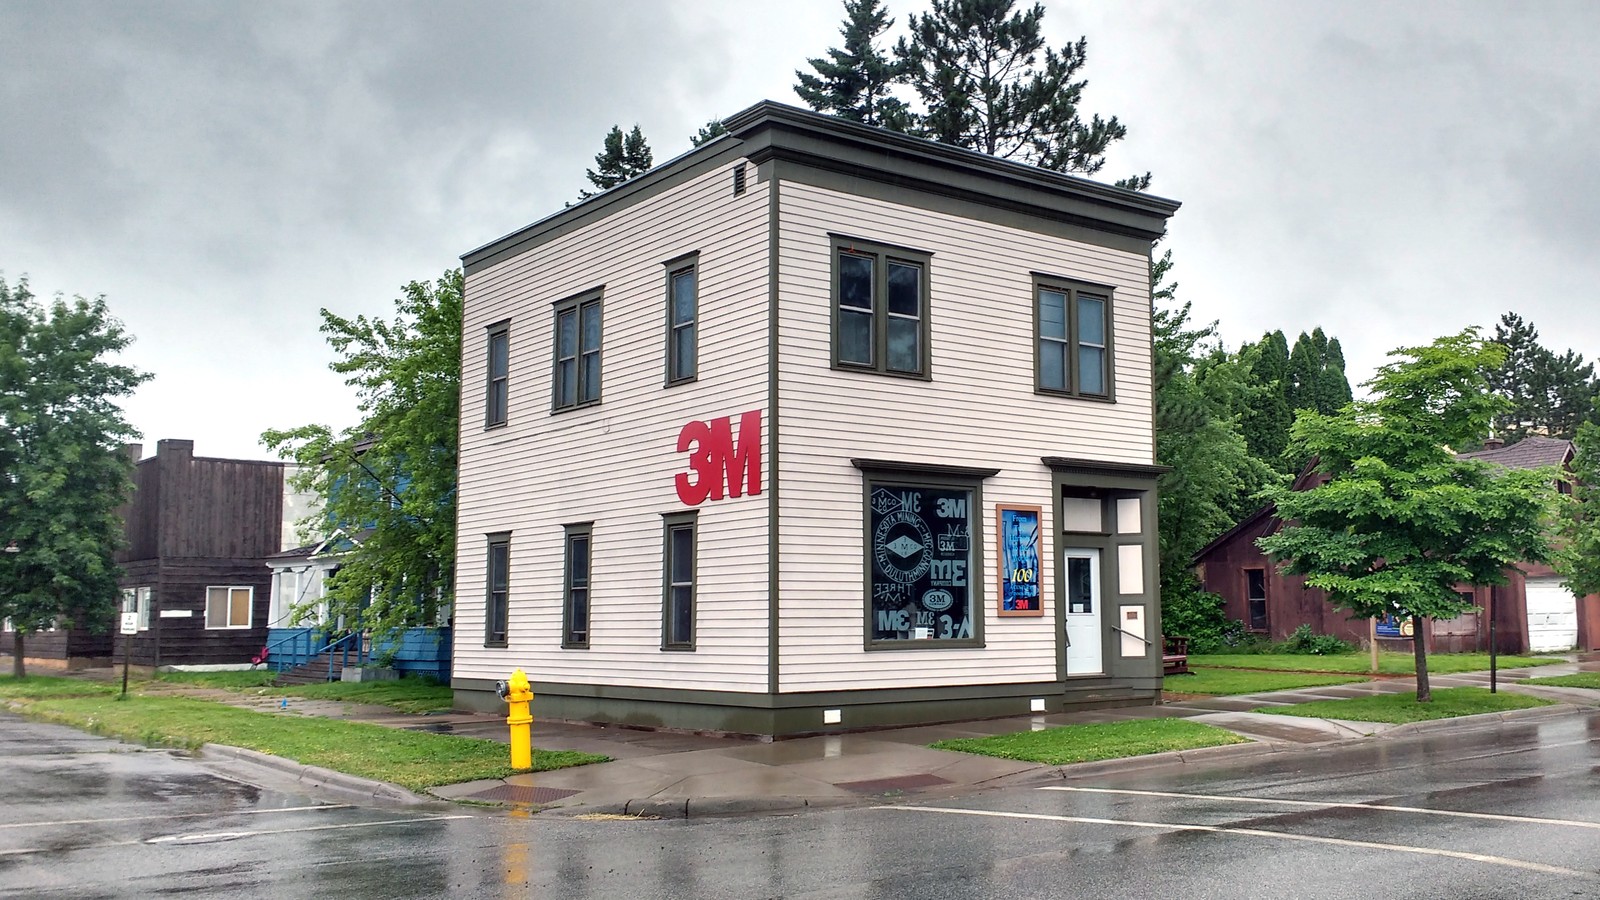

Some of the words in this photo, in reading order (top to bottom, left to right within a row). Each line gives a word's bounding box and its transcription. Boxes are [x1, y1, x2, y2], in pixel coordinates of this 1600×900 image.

[675, 409, 762, 506] 3M
[936, 498, 965, 518] 3M
[876, 514, 897, 563] MINNESOTA
[940, 541, 955, 551] 3M
[884, 564, 915, 581] DULUTH
[1012, 568, 1032, 582] 100
[929, 595, 945, 603] 3M
[1015, 600, 1028, 609] 3M
